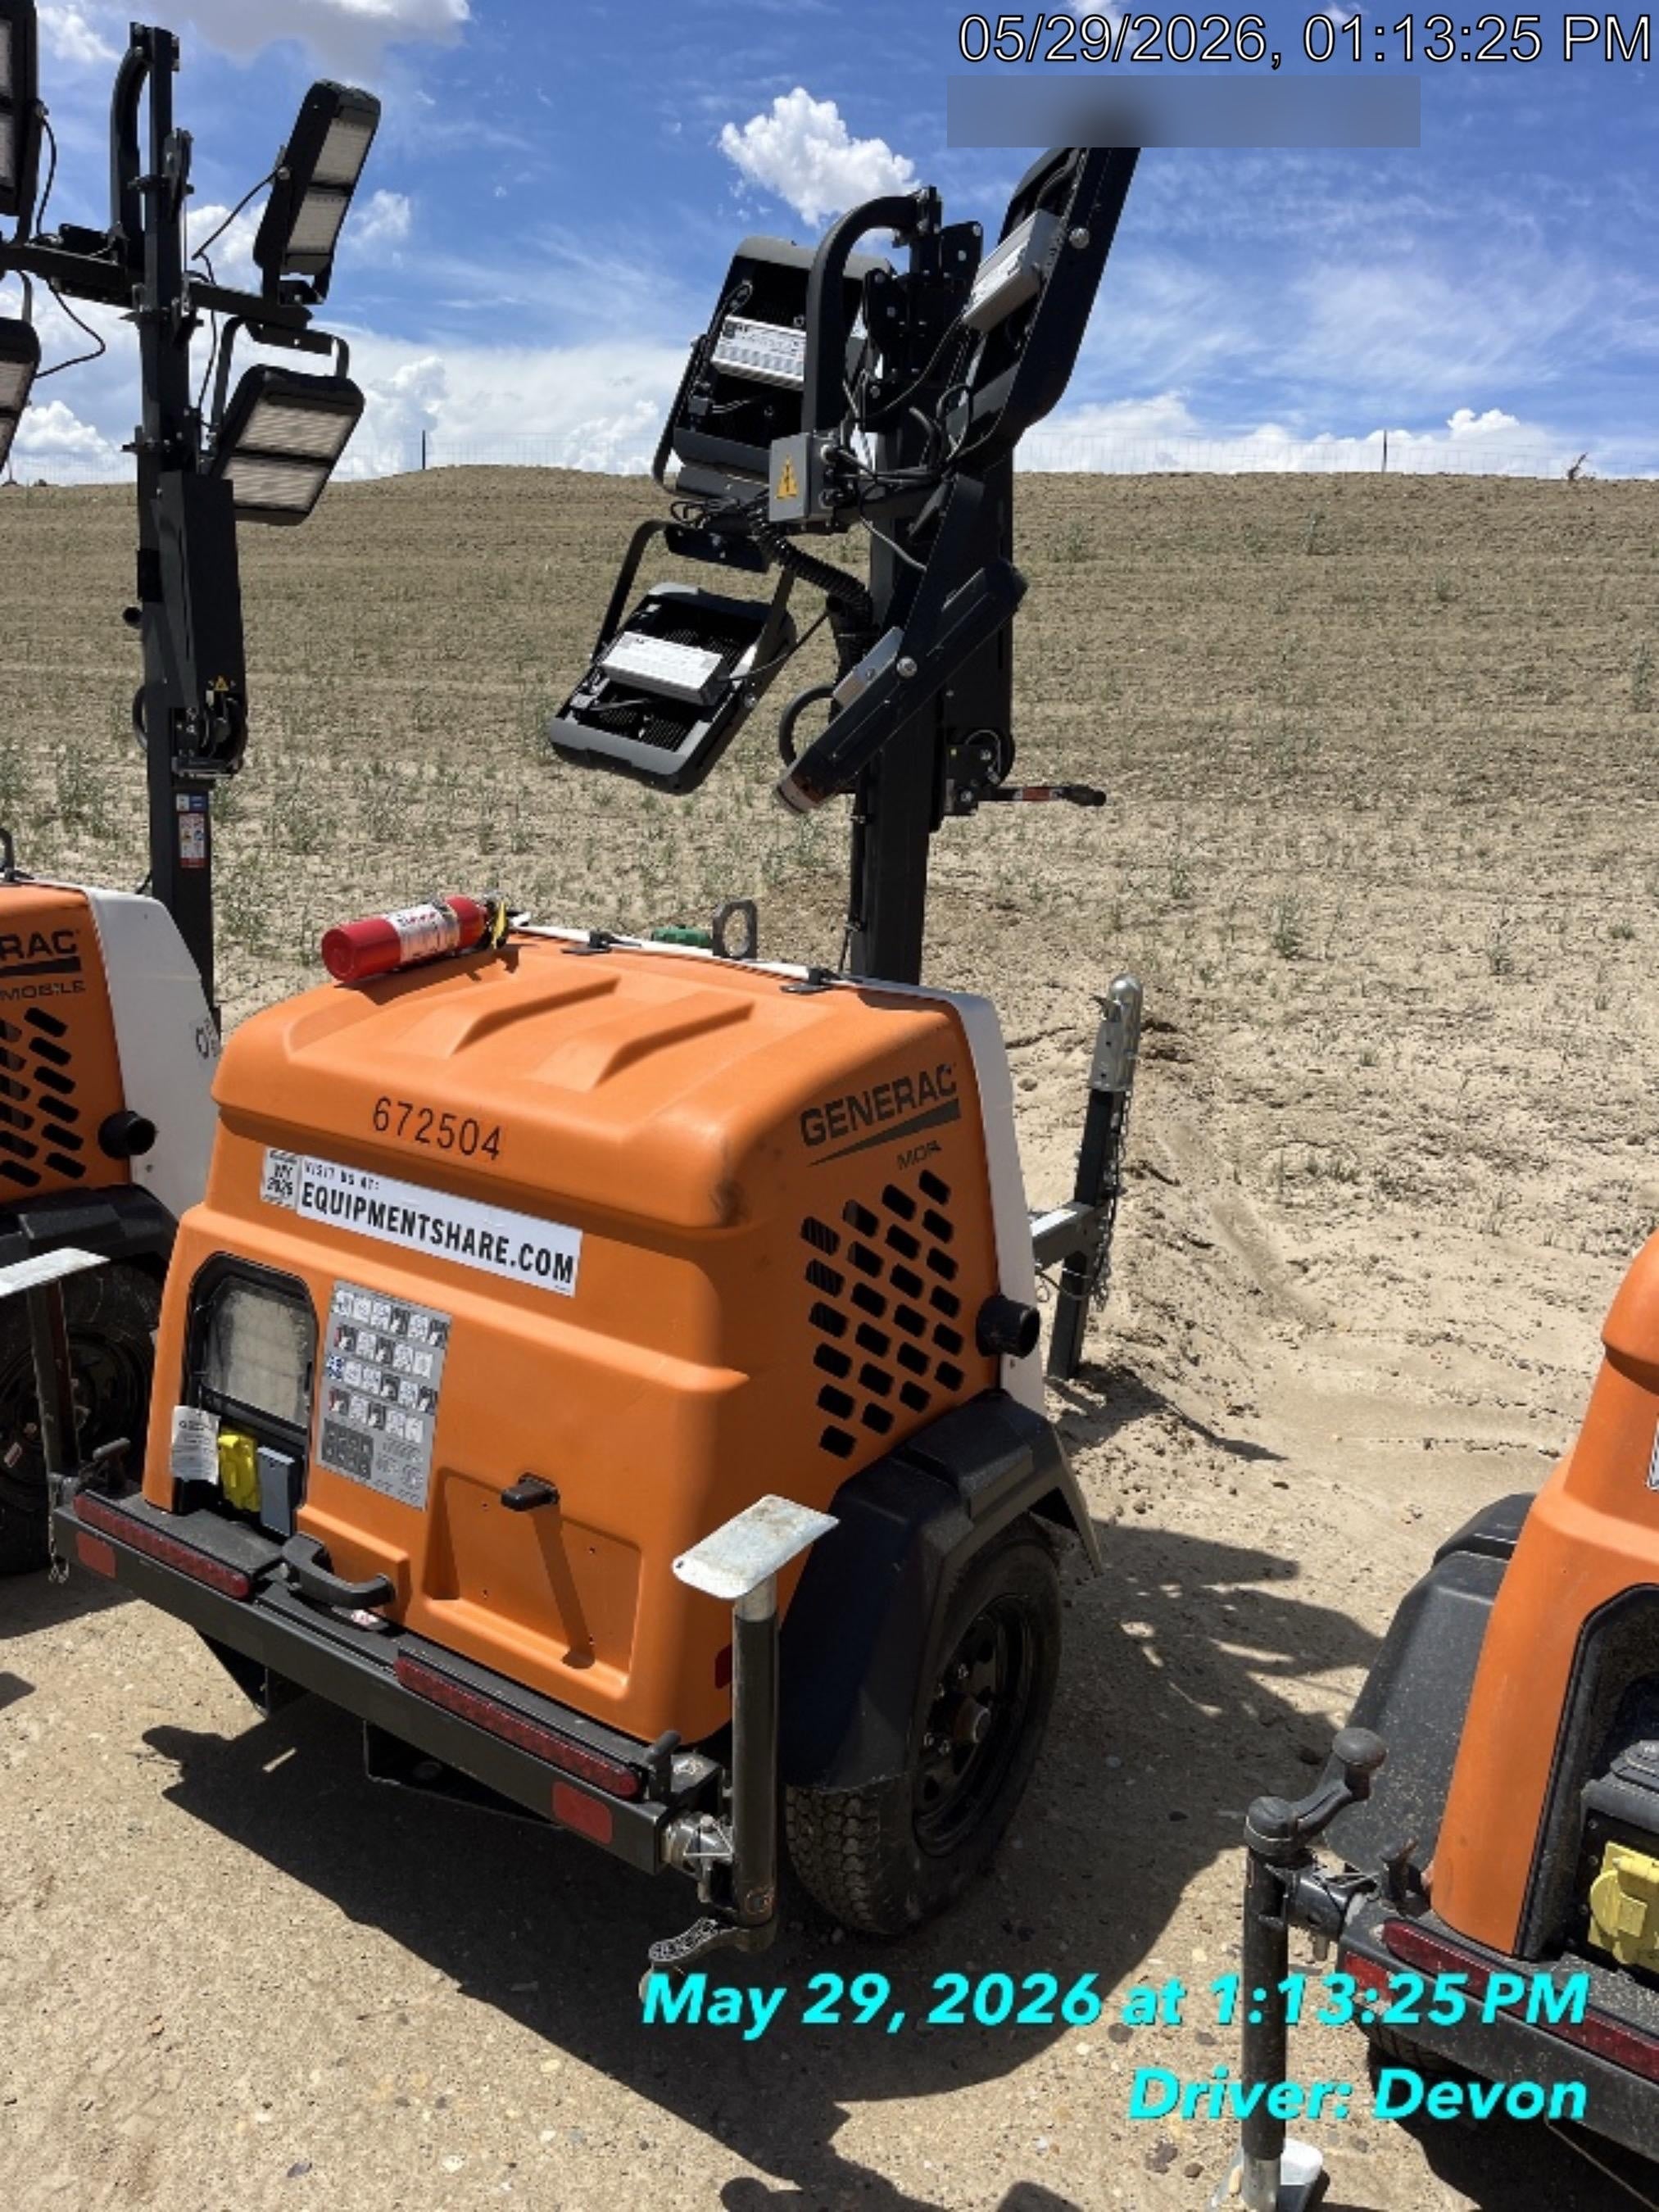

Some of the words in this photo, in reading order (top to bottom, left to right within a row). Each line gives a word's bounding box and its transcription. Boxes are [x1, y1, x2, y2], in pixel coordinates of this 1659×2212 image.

[373, 1096, 501, 1160] 672504
[800, 1063, 957, 1147] GENERAC
[301, 1181, 574, 1284] EQUIPMENTSHARE.COM
